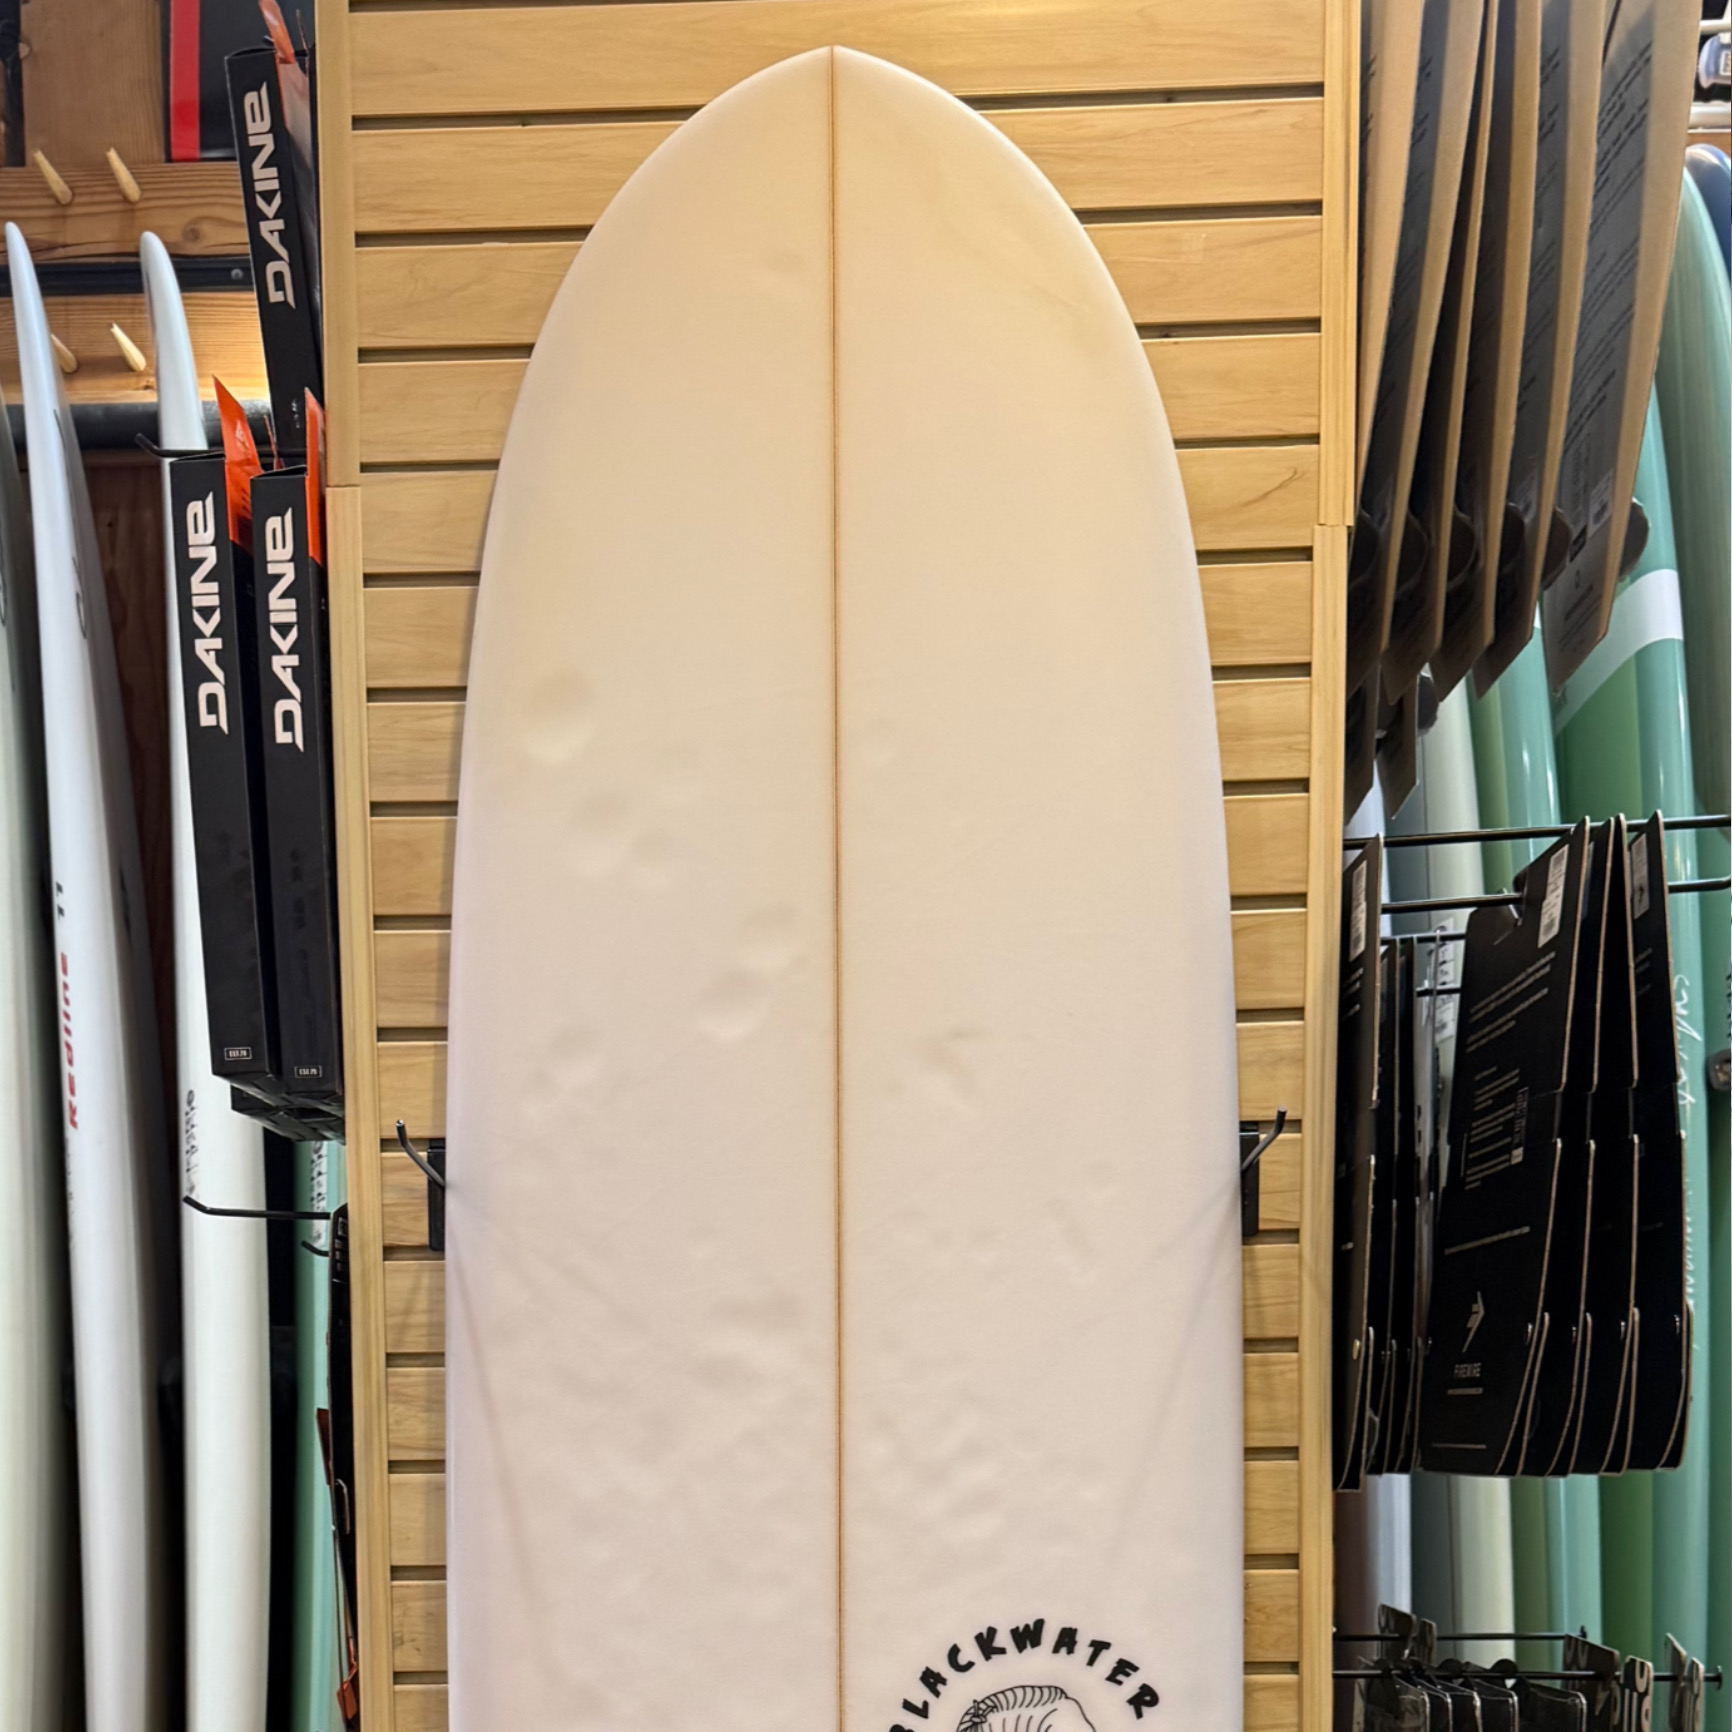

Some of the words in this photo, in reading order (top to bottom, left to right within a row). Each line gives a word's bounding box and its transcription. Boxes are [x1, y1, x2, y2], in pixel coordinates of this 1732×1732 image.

[243, 81, 295, 309] DAKINE
[186, 491, 229, 735] DAKINE
[264, 506, 304, 752] DAKINE
